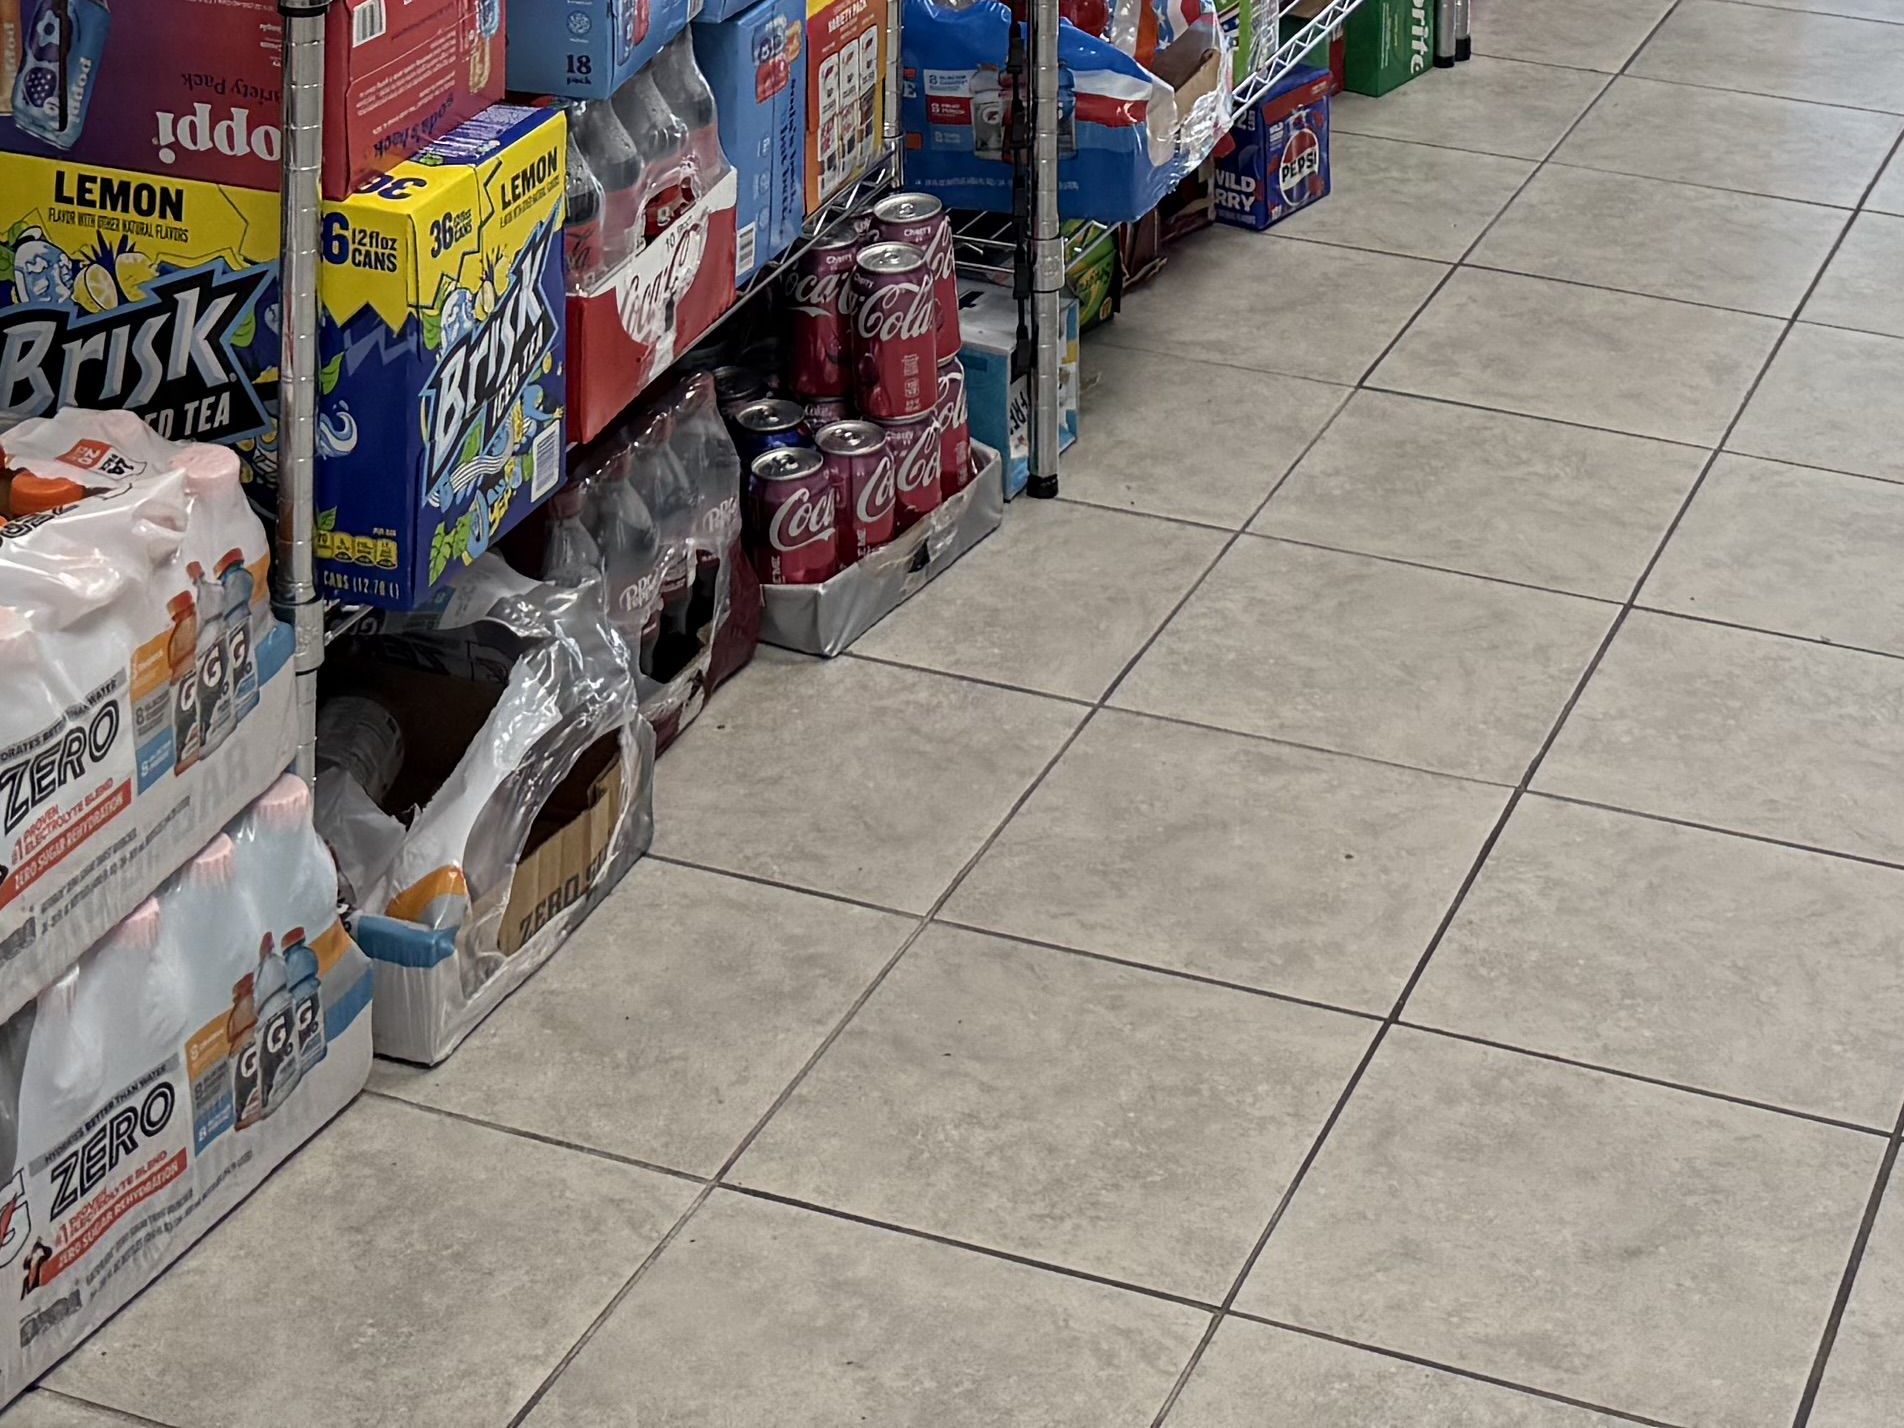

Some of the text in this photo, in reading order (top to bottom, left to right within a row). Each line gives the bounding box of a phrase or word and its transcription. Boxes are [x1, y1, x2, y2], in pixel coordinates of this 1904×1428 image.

[827, 4, 852, 33] VARIETY
[566, 54, 593, 75] 18
[566, 74, 592, 87] pack
[181, 72, 226, 95] Pack
[155, 101, 282, 166] oppi
[500, 146, 559, 210] LEMON
[1280, 149, 1319, 183] PEPSI
[53, 170, 185, 222] LEMON
[48, 206, 190, 245] FLAVOR WITH OTHER NATURAL FLAVORS
[430, 211, 455, 260] 36
[351, 249, 398, 273] CANS
[432, 240, 545, 480] Brisk
[492, 323, 544, 428] ICED TEA
[183, 393, 233, 438] TEA
[82, 447, 101, 468] 20
[108, 455, 135, 477] 24
[323, 570, 349, 590] CANS
[87, 678, 119, 707] WATER
[23, 804, 60, 841] PROVEN
[48, 1081, 177, 1223] ZERO
[132, 1147, 169, 1183] BLEND
[57, 1239, 83, 1270] ZERO
